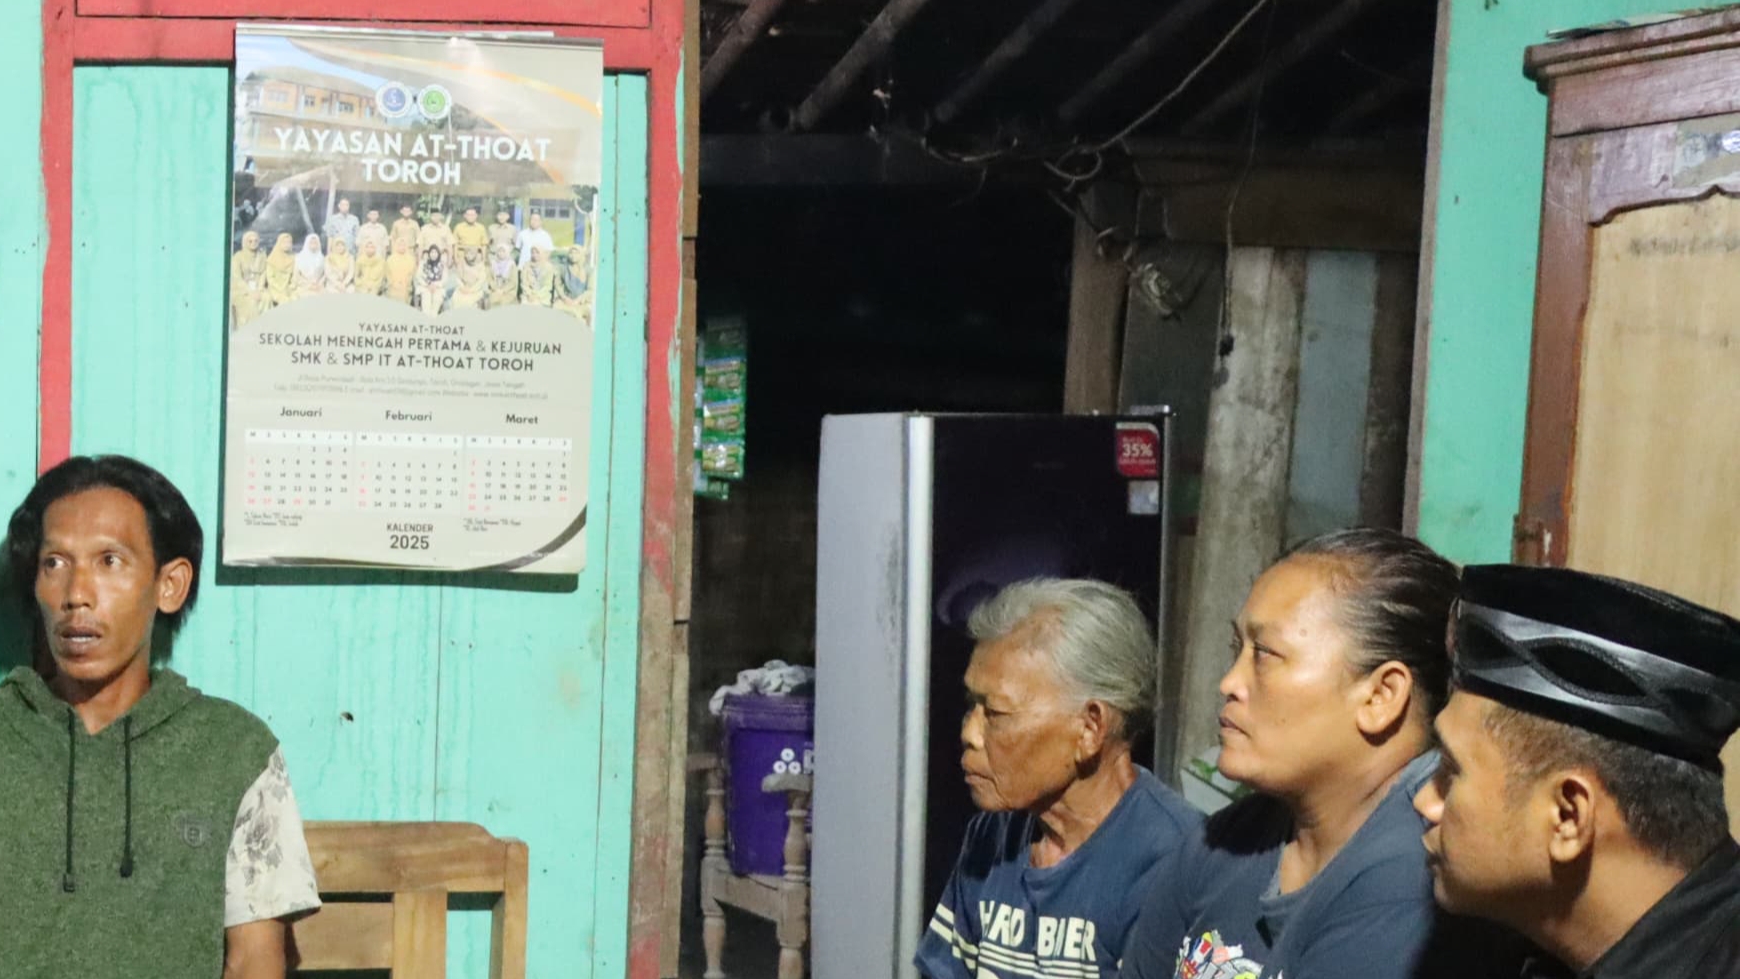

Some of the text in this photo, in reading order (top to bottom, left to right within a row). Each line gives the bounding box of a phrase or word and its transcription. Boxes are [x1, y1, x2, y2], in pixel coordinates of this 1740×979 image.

[275, 127, 552, 162] YAYASAN AT-THOAT
[361, 158, 461, 186] TOROH
[359, 322, 465, 336] YAYASAN AT-THOAT
[259, 332, 562, 355] SEKOLAH MENENGAH PERTAMA & KEJURUAN
[291, 351, 533, 372] SMK & SMP IT AT-THOAT TOROH
[280, 406, 323, 418] Januari
[385, 410, 433, 422] Februari
[505, 413, 539, 425] Maret
[1122, 443, 1154, 457] 35%
[386, 522, 434, 533] KALENDER
[389, 534, 430, 550] 2025
[1037, 916, 1097, 962] BIER
